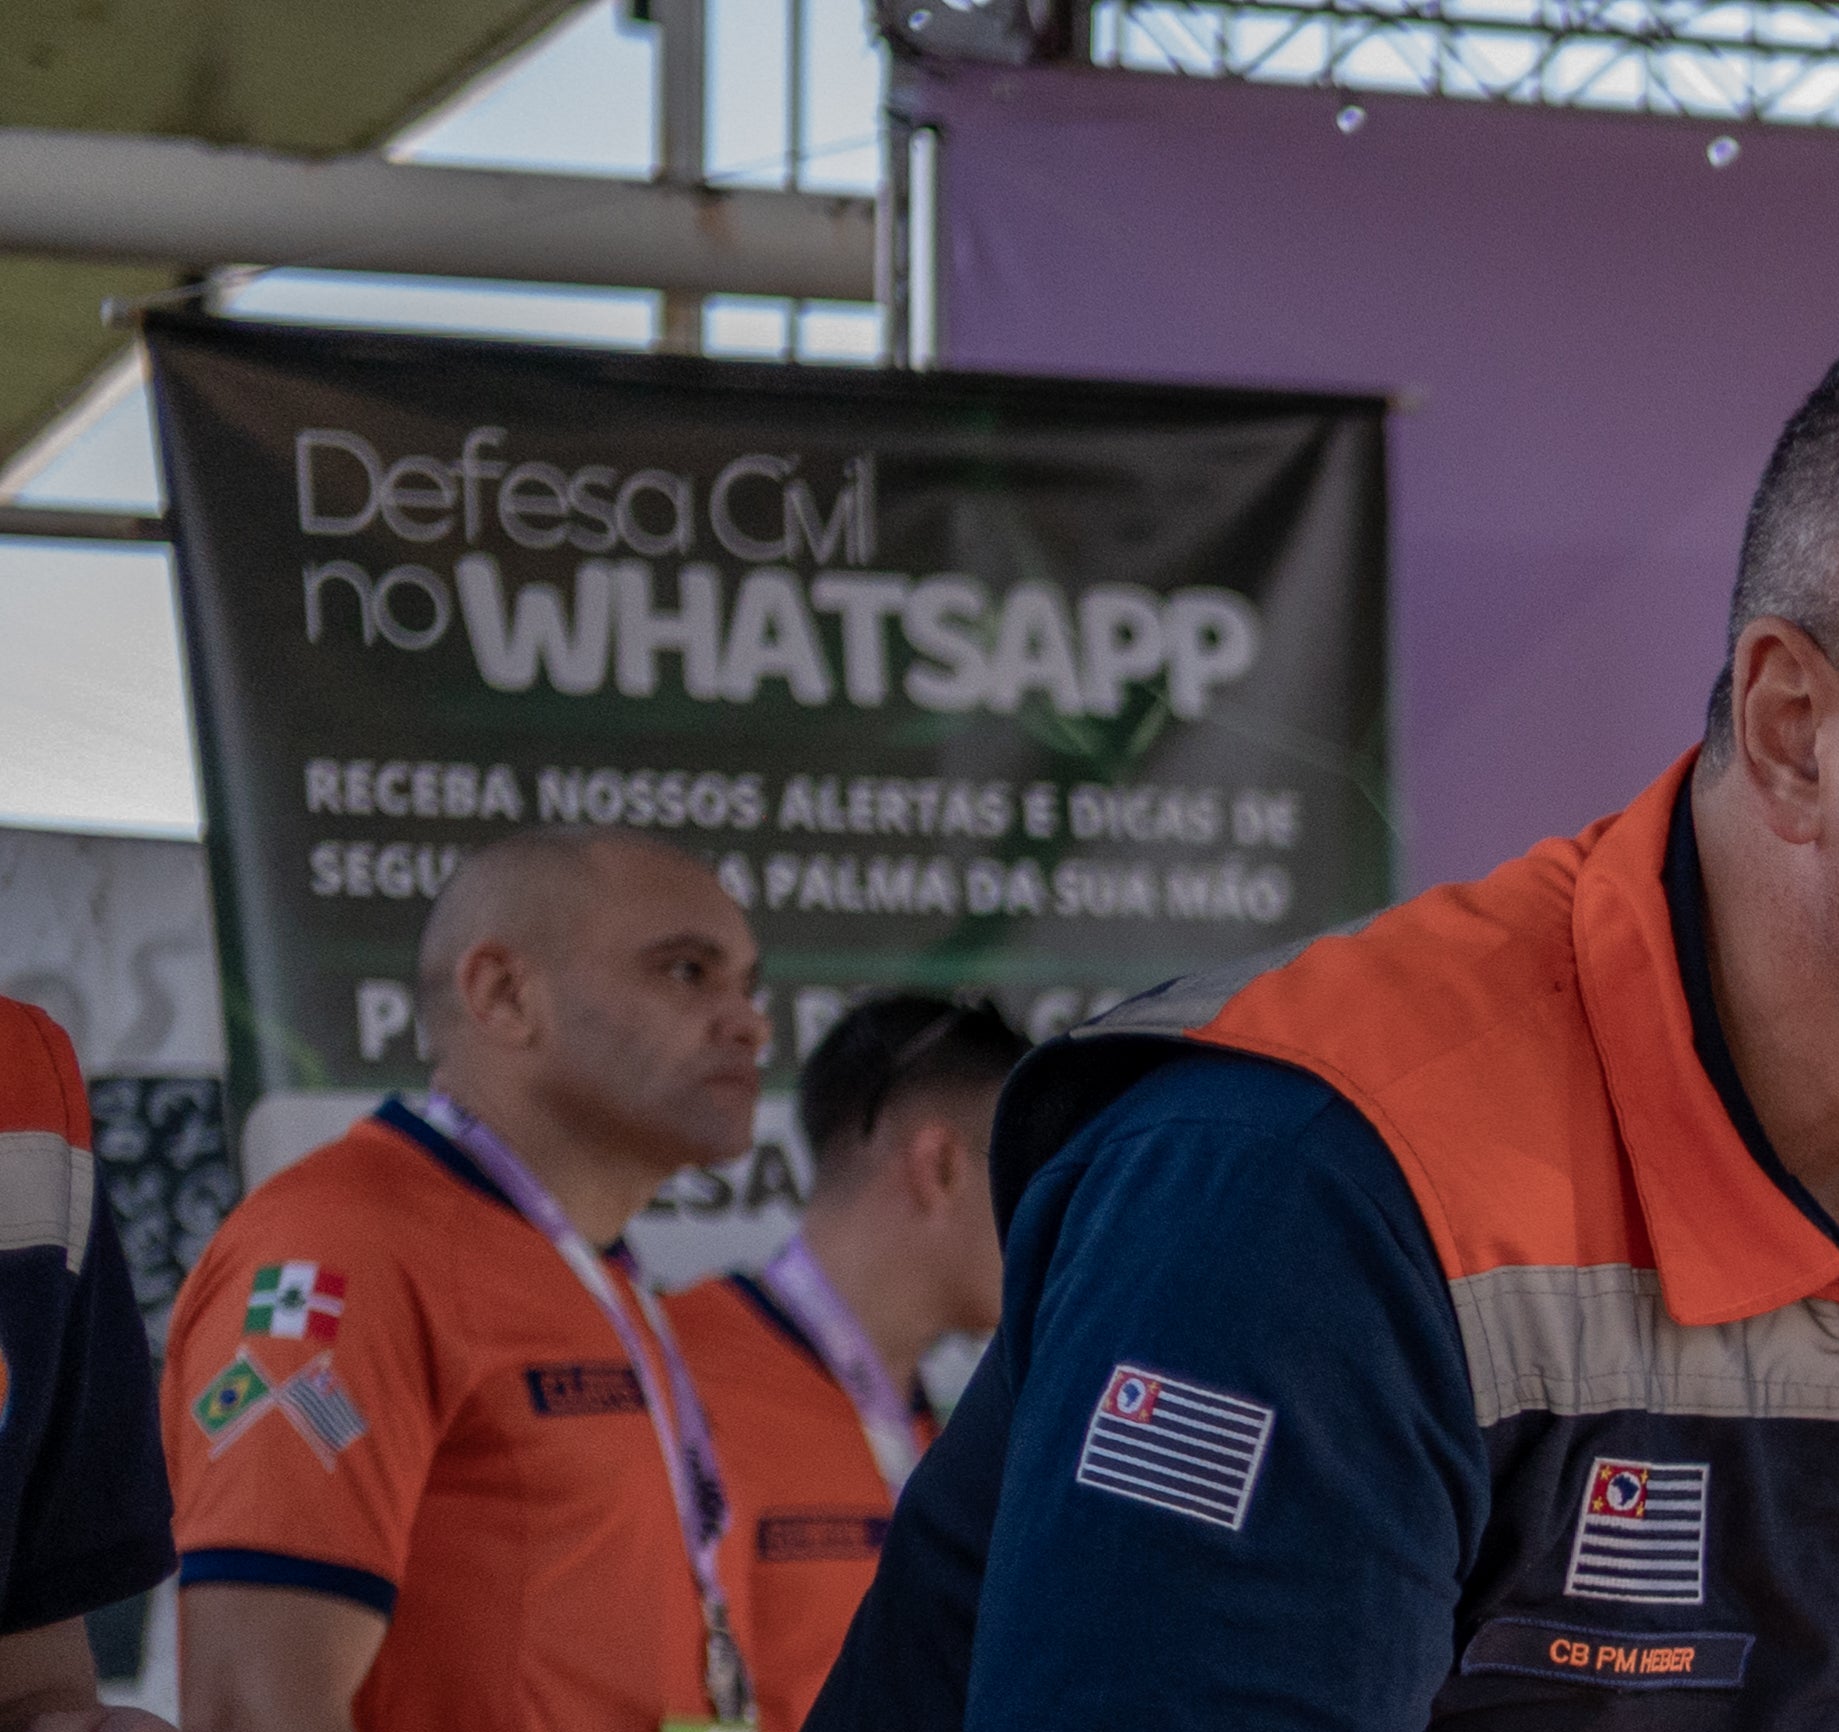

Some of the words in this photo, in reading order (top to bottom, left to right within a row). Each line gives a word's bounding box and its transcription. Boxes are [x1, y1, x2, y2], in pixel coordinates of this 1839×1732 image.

[296, 426, 694, 556] Defesa
[710, 451, 880, 566] Civil
[302, 556, 452, 650] no
[456, 554, 1260, 720] WHATSAPP
[304, 760, 523, 822] RECEBA
[535, 767, 765, 830] NOSSOS
[780, 774, 1012, 838] ALERTAS
[1022, 780, 1058, 838] E
[1069, 782, 1217, 845] DICAS
[1231, 786, 1299, 848] DE
[764, 852, 961, 915] PALMA
[965, 855, 1045, 916] DA
[1052, 860, 1157, 918] SUA
[1166, 853, 1292, 923] MÃO
[1549, 1638, 1590, 1667] CB
[1595, 1645, 1638, 1674] PM
[1639, 1646, 1695, 1673] HEBER
